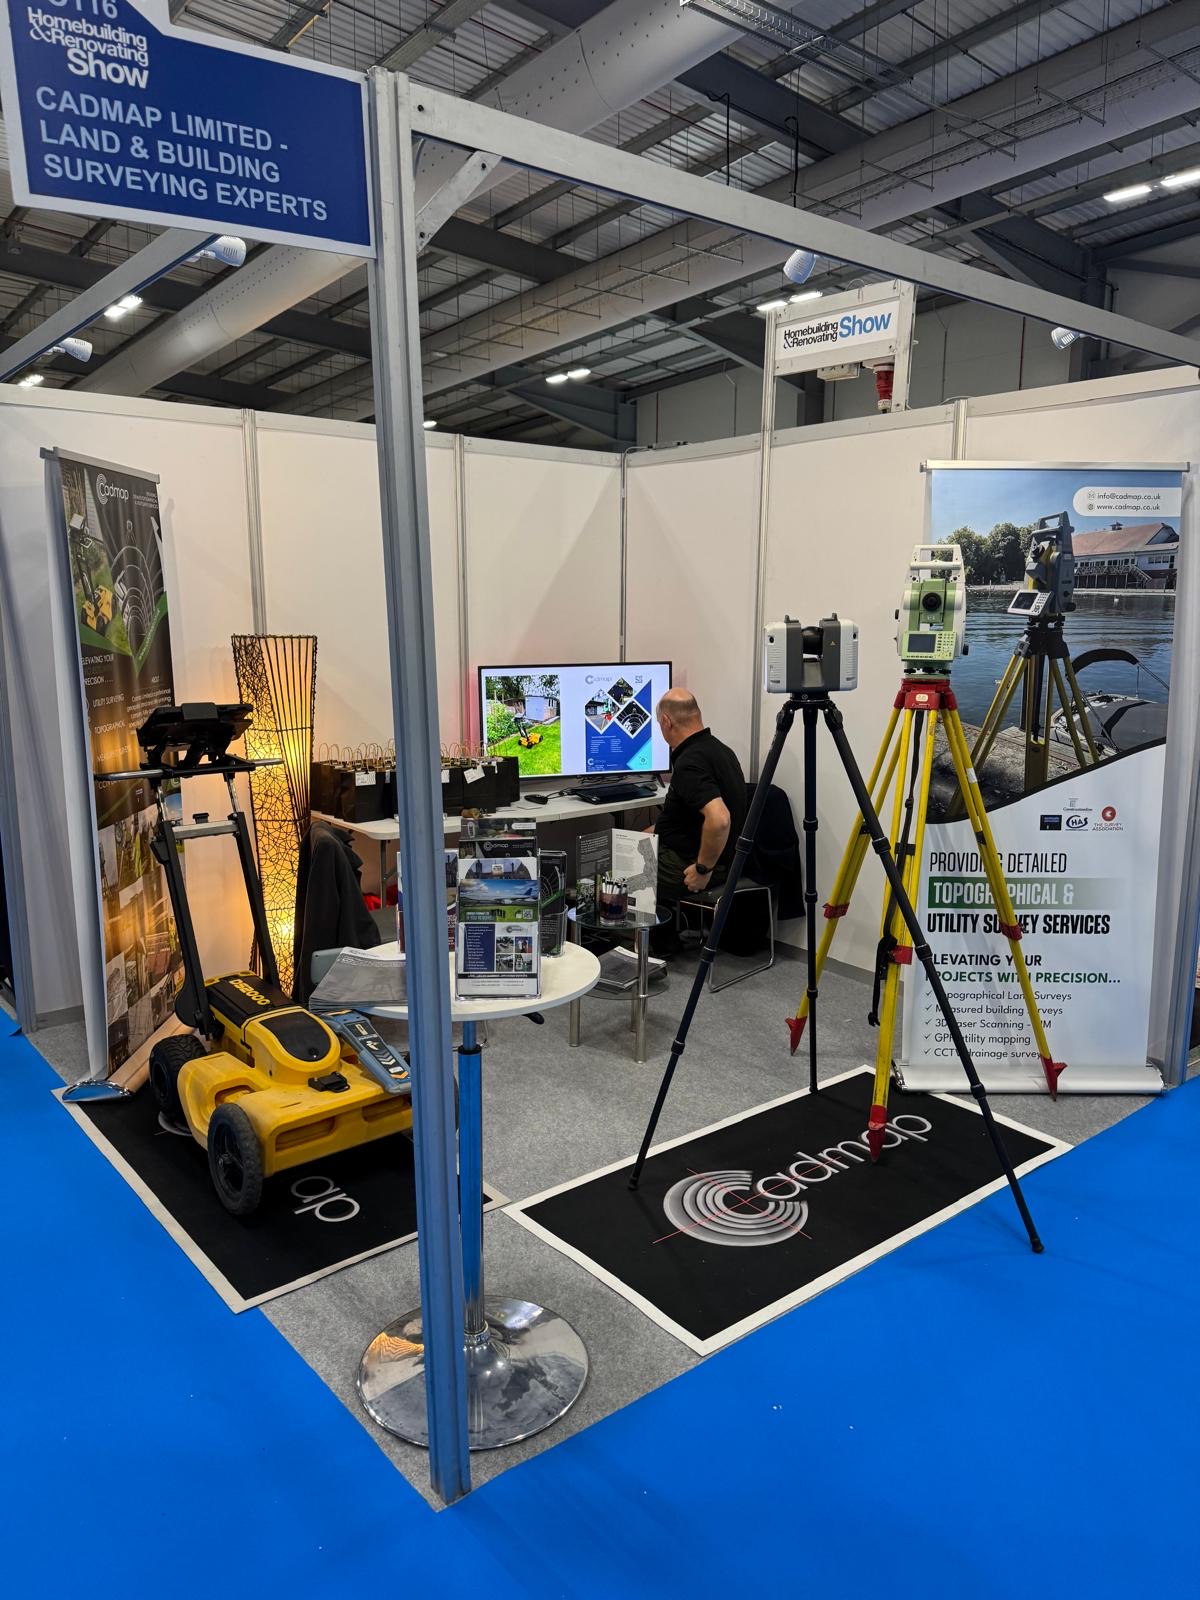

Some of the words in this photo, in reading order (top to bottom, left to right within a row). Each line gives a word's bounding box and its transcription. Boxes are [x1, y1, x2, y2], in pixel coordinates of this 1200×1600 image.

[49, 0, 118, 19] 16
[27, 6, 147, 50] Homebuilding
[29, 20, 149, 67] &Renovating
[67, 48, 149, 88] Show
[36, 86, 162, 129] CADMAP
[171, 112, 272, 150] LIMITED
[40, 119, 120, 154] LAND
[131, 136, 149, 159] &
[158, 140, 280, 183] BUILDING
[44, 153, 208, 201] SURVEYING
[216, 183, 328, 221] EXPERTS
[784, 321, 839, 339] Homebuilding
[838, 312, 892, 338] Show
[1097, 492, 1161, 501] info@cadmap.co.uk
[1096, 503, 1160, 512] www.cadmap.co.uk
[929, 852, 1003, 873] PROVIDI
[1007, 852, 1067, 873] DETAILED
[933, 882, 1059, 905] TOPOGRPHICAL
[1063, 883, 1074, 905] &
[927, 913, 979, 933] UTILITY
[983, 913, 1040, 934] SUVEY
[1043, 914, 1111, 934] SERVICES
[933, 953, 1002, 966] LEVATING
[1005, 954, 1042, 966] YUR
[997, 972, 1031, 983] WIT
[1036, 972, 1121, 984] PRECISION...
[946, 990, 1005, 1001] pographical
[1008, 991, 1026, 1000] Lan
[1034, 991, 1072, 1001] Surveys
[935, 1005, 983, 1014] Masured
[985, 1005, 1024, 1017] building
[1027, 1008, 1063, 1017] rveys
[980, 1019, 1024, 1031] Scanning
[963, 1033, 986, 1046] tility
[988, 1034, 1031, 1046] mapping
